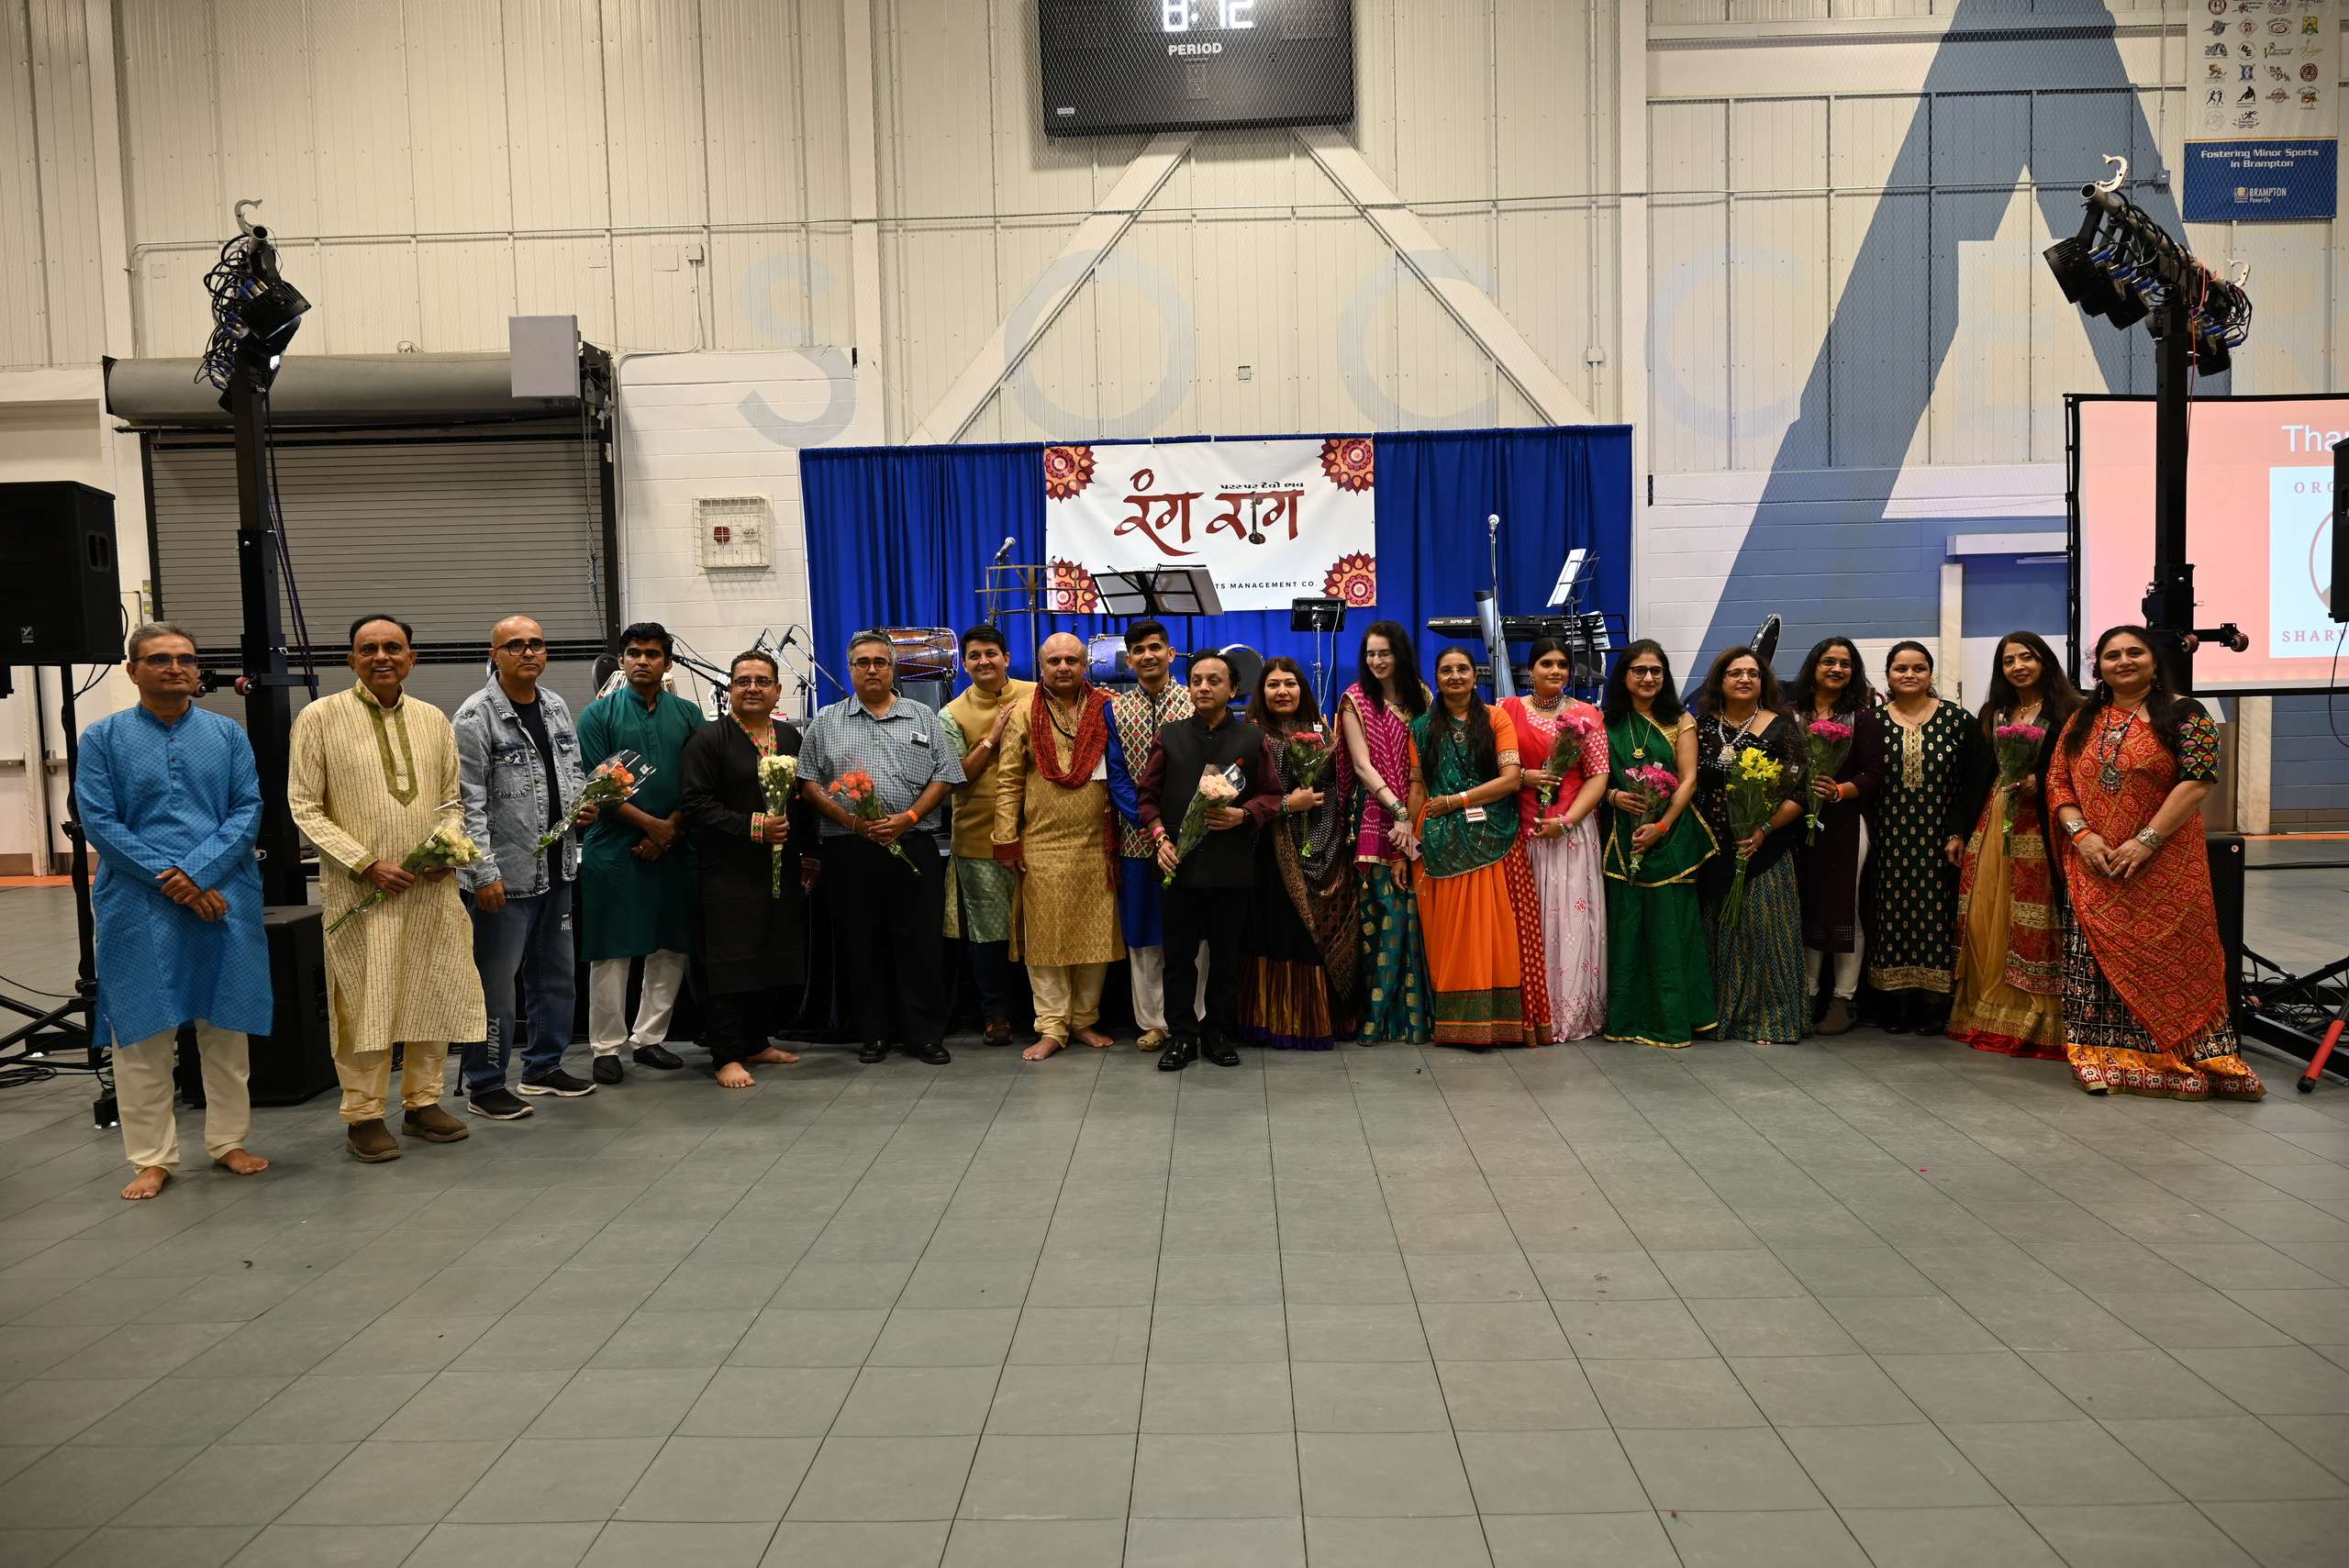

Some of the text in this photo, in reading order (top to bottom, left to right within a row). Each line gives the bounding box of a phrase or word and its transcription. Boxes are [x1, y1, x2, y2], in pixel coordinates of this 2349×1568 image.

[1168, 42, 1222, 56] PERIOD
[2201, 148, 2320, 159] Fostering Minor Sports
[2243, 160, 2295, 169] Brampton
[2249, 187, 2287, 197] BRAMPTON
[2282, 425, 2349, 452] Tha
[561, 920, 573, 931] HIL
[487, 1017, 500, 1069] TOMMY
